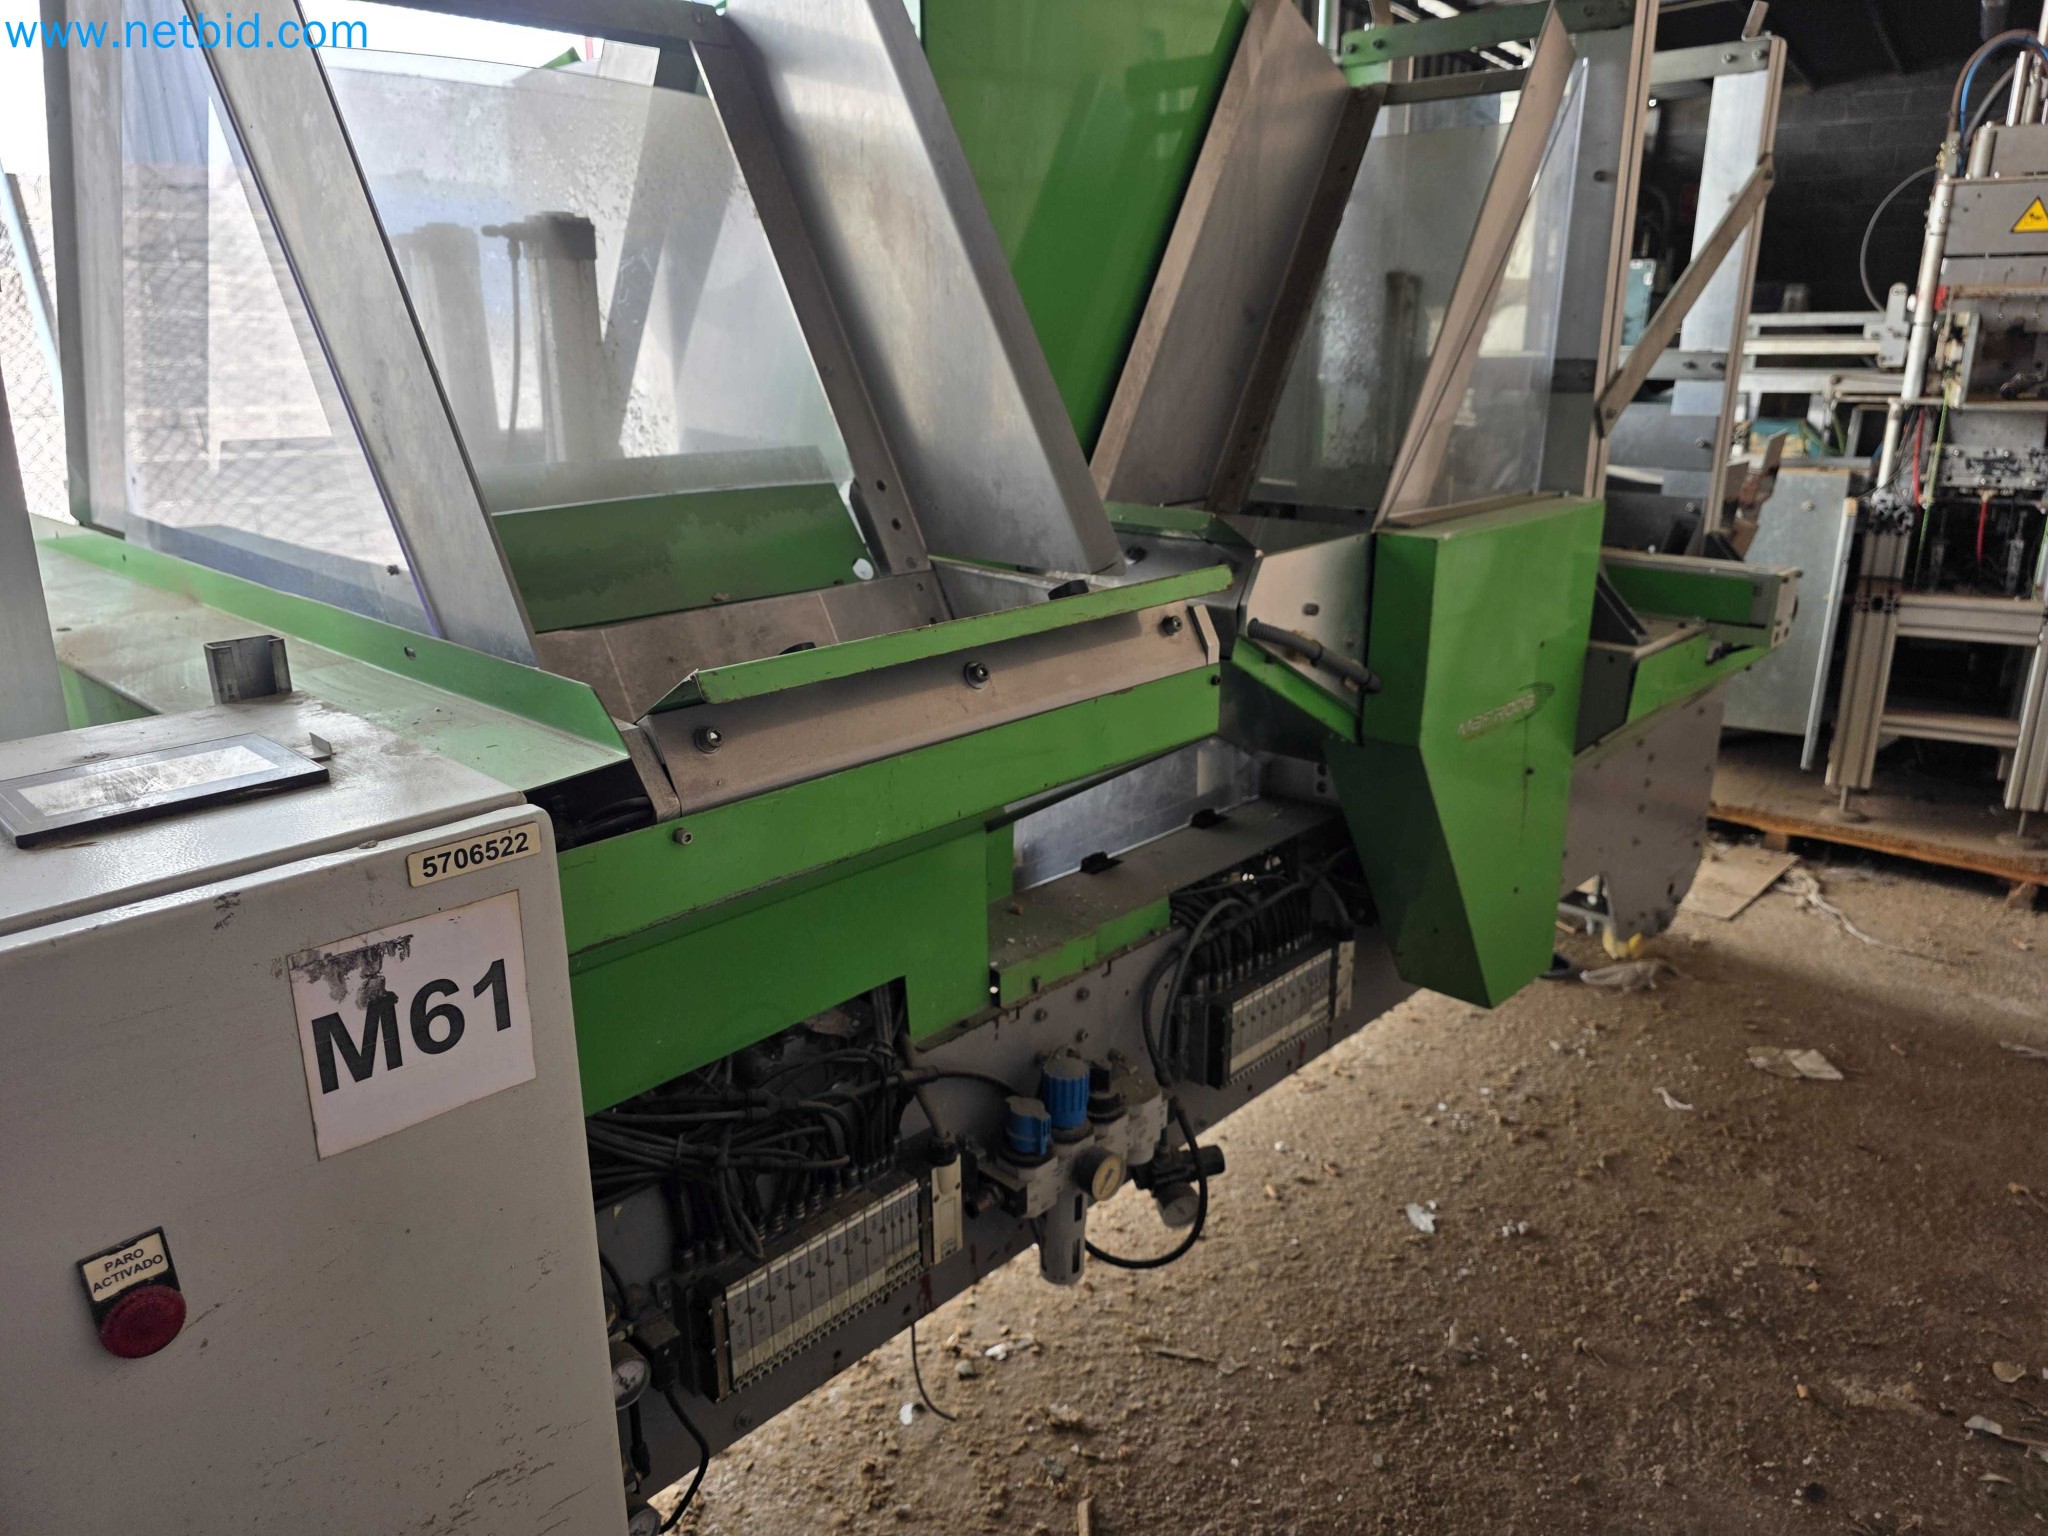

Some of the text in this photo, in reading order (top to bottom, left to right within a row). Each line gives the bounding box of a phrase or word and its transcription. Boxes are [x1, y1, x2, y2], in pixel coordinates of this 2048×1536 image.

[422, 832, 529, 878] 5706522
[311, 958, 512, 1094] M61
[93, 1254, 164, 1293] ACTIVADO
[104, 1248, 144, 1272] PARO
